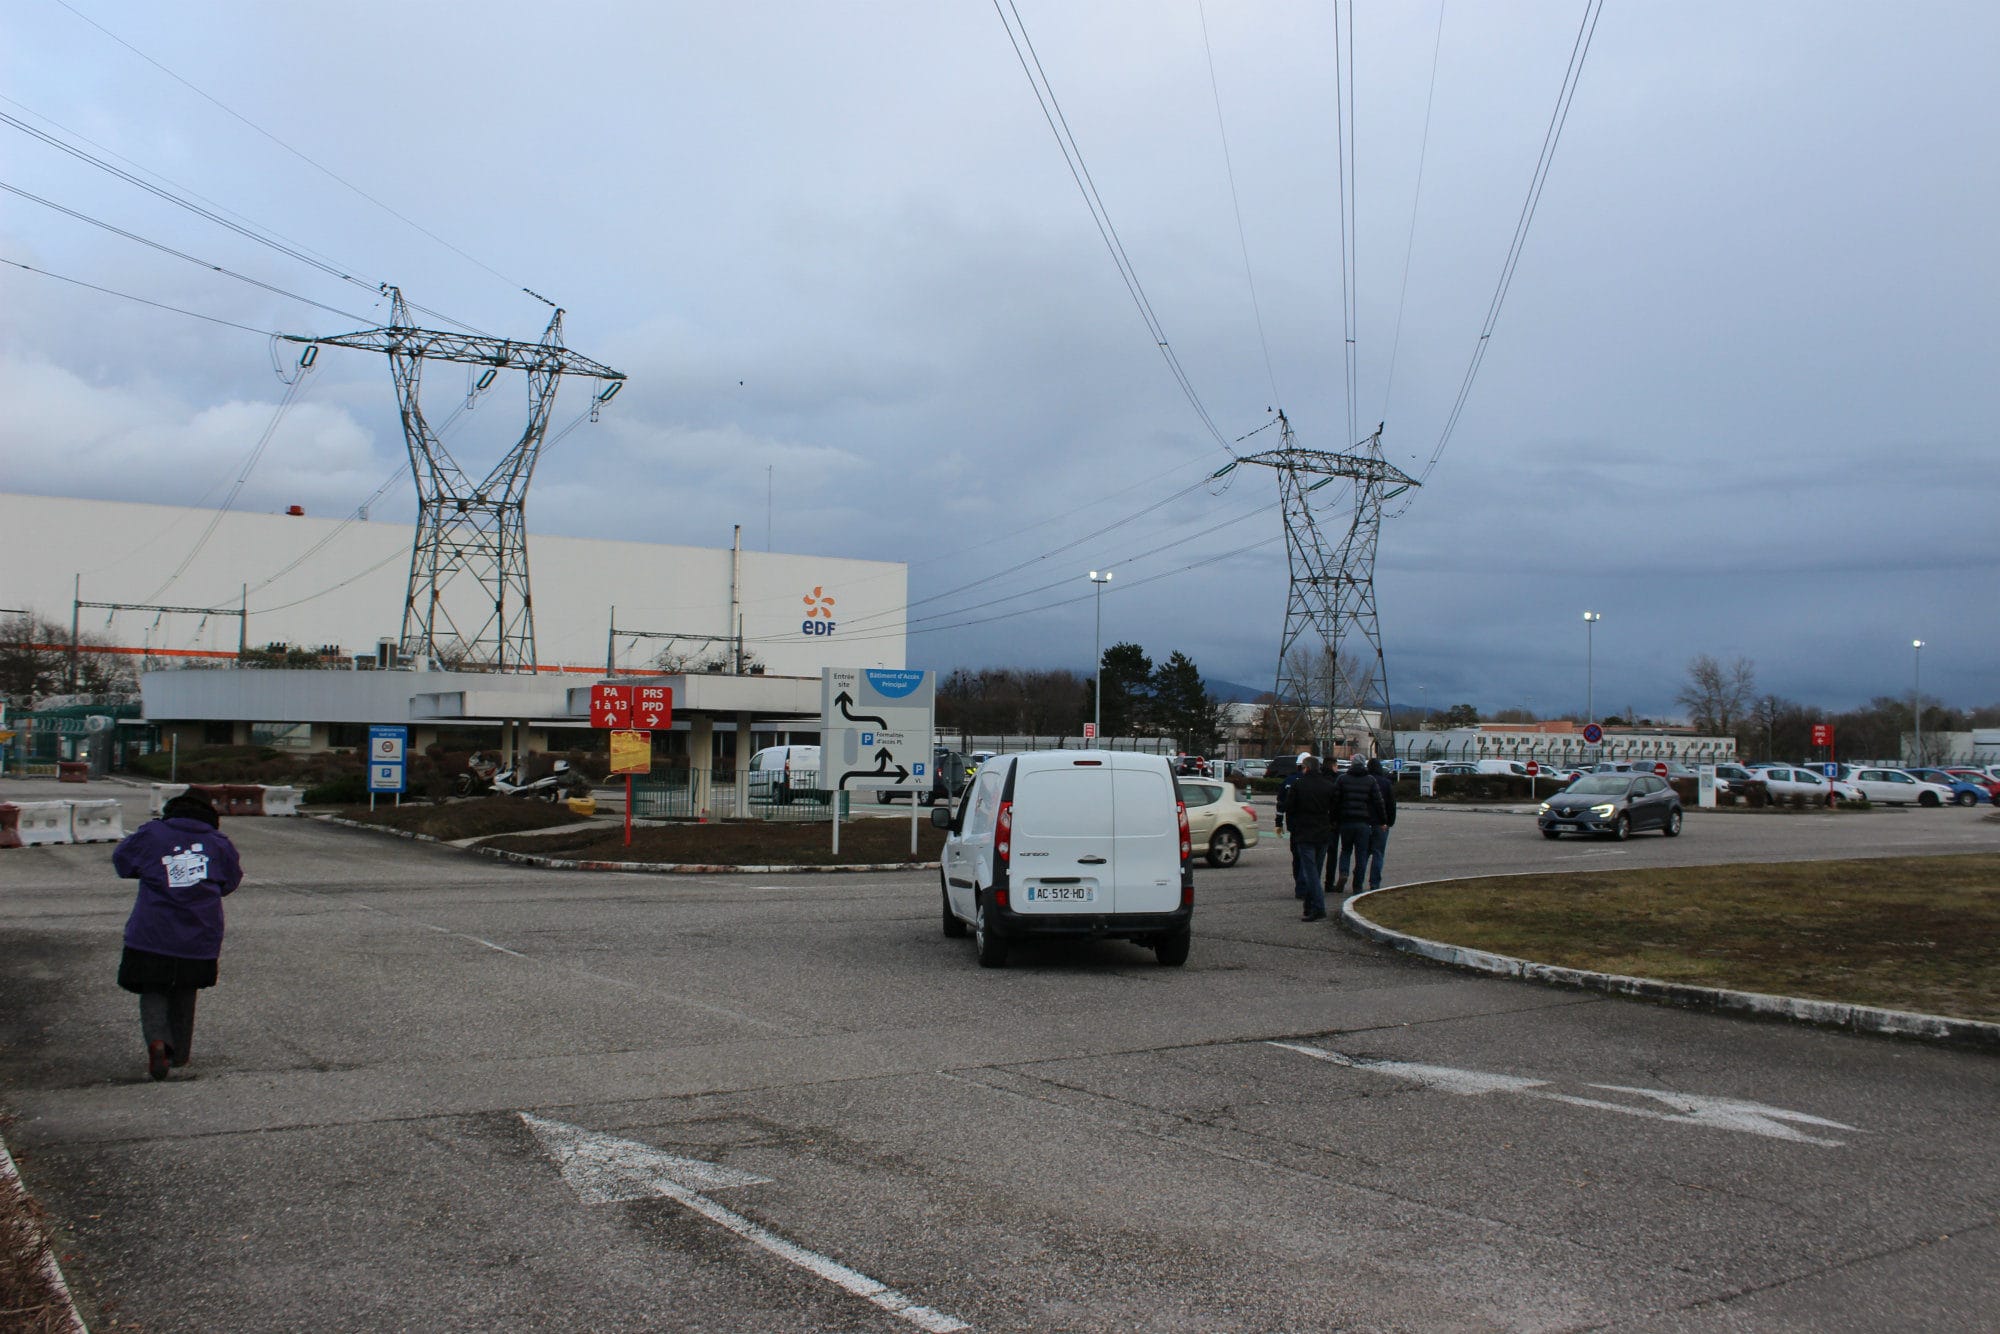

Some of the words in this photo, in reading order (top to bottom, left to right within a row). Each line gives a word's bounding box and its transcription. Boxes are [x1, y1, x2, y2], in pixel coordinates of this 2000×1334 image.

[881, 681, 907, 689] Principal
[603, 687, 619, 697] PA
[643, 688, 664, 699] PRS
[594, 700, 601, 710] 1
[604, 700, 611, 710] à
[614, 700, 628, 710] 13
[642, 701, 664, 712] PPD
[864, 734, 872, 744] P
[915, 765, 923, 773] P
[1037, 888, 1085, 899] AC-512-HD
